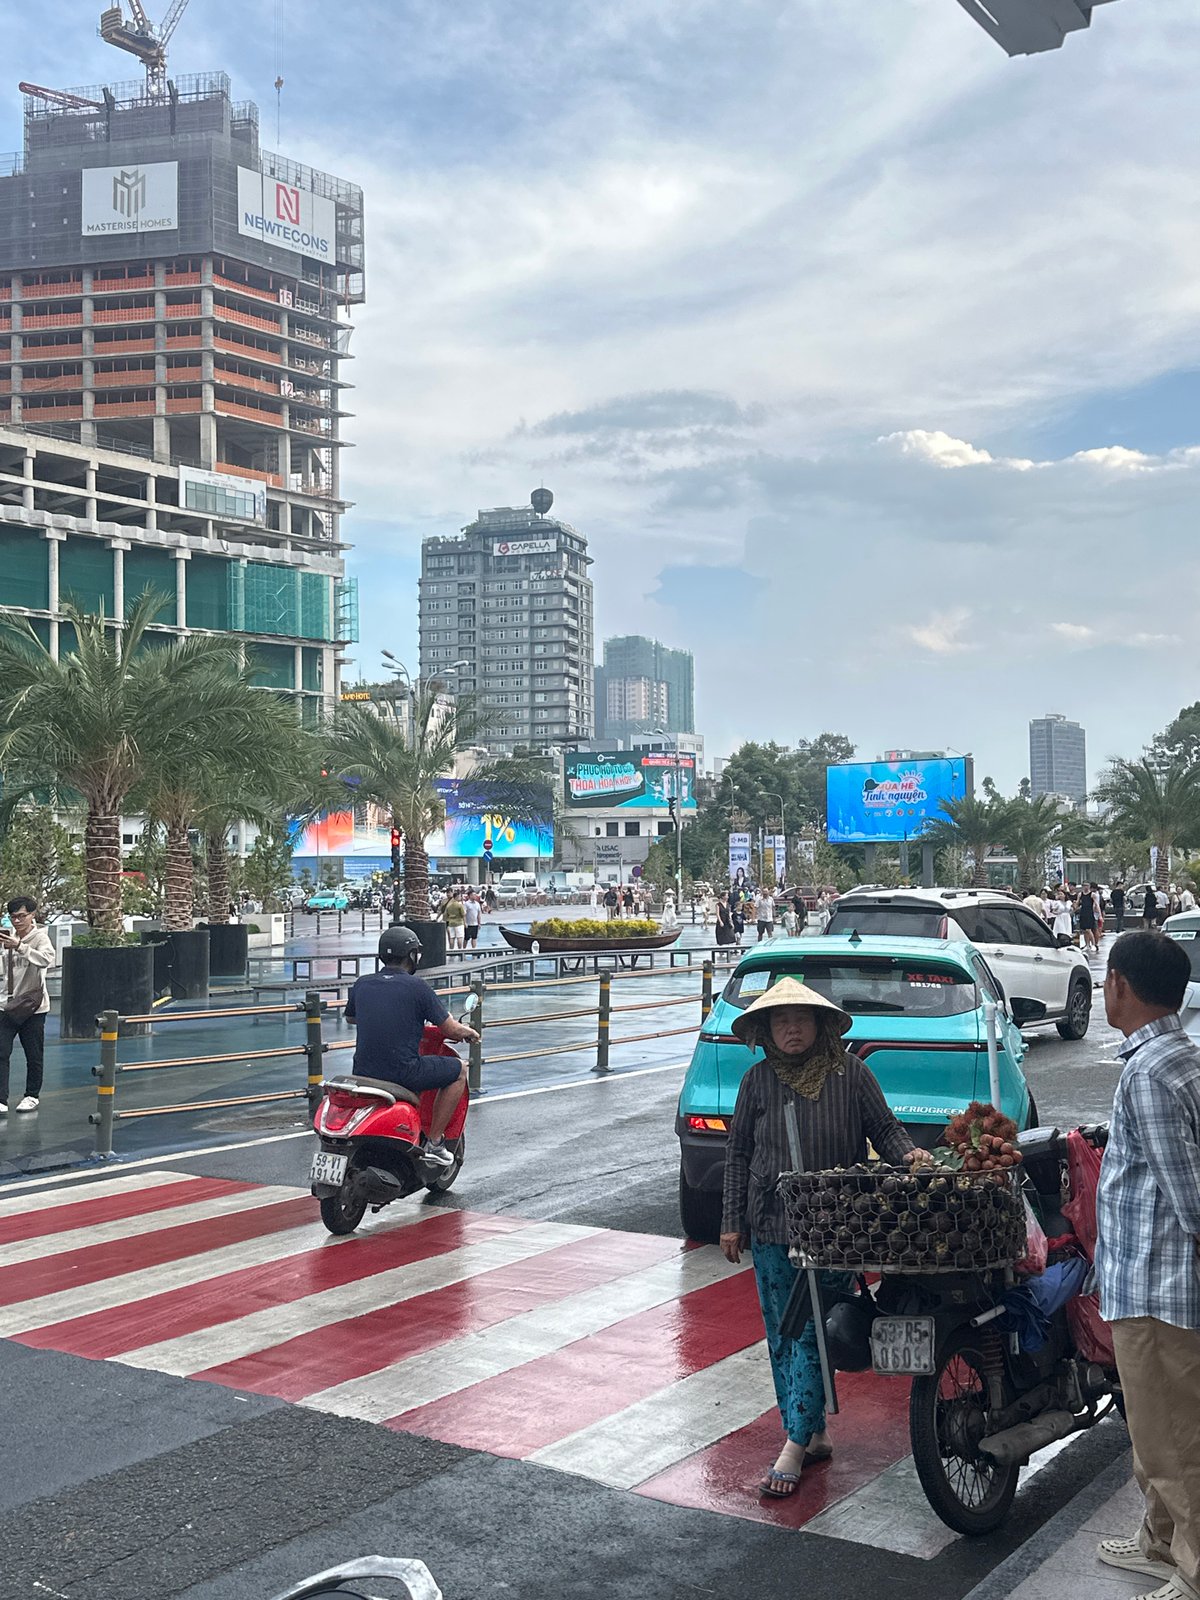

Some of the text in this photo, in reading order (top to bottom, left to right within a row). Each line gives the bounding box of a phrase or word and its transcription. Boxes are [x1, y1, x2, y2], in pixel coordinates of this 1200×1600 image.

[87, 218, 172, 232] MASTERISE HOMES
[244, 212, 328, 253] NEWTECONS
[280, 291, 292, 308] 15
[281, 382, 293, 397] 12
[511, 541, 550, 551] CAPELLA
[888, 789, 925, 803] nguyện
[480, 813, 515, 843] 1%
[906, 973, 954, 985] XE TAXI
